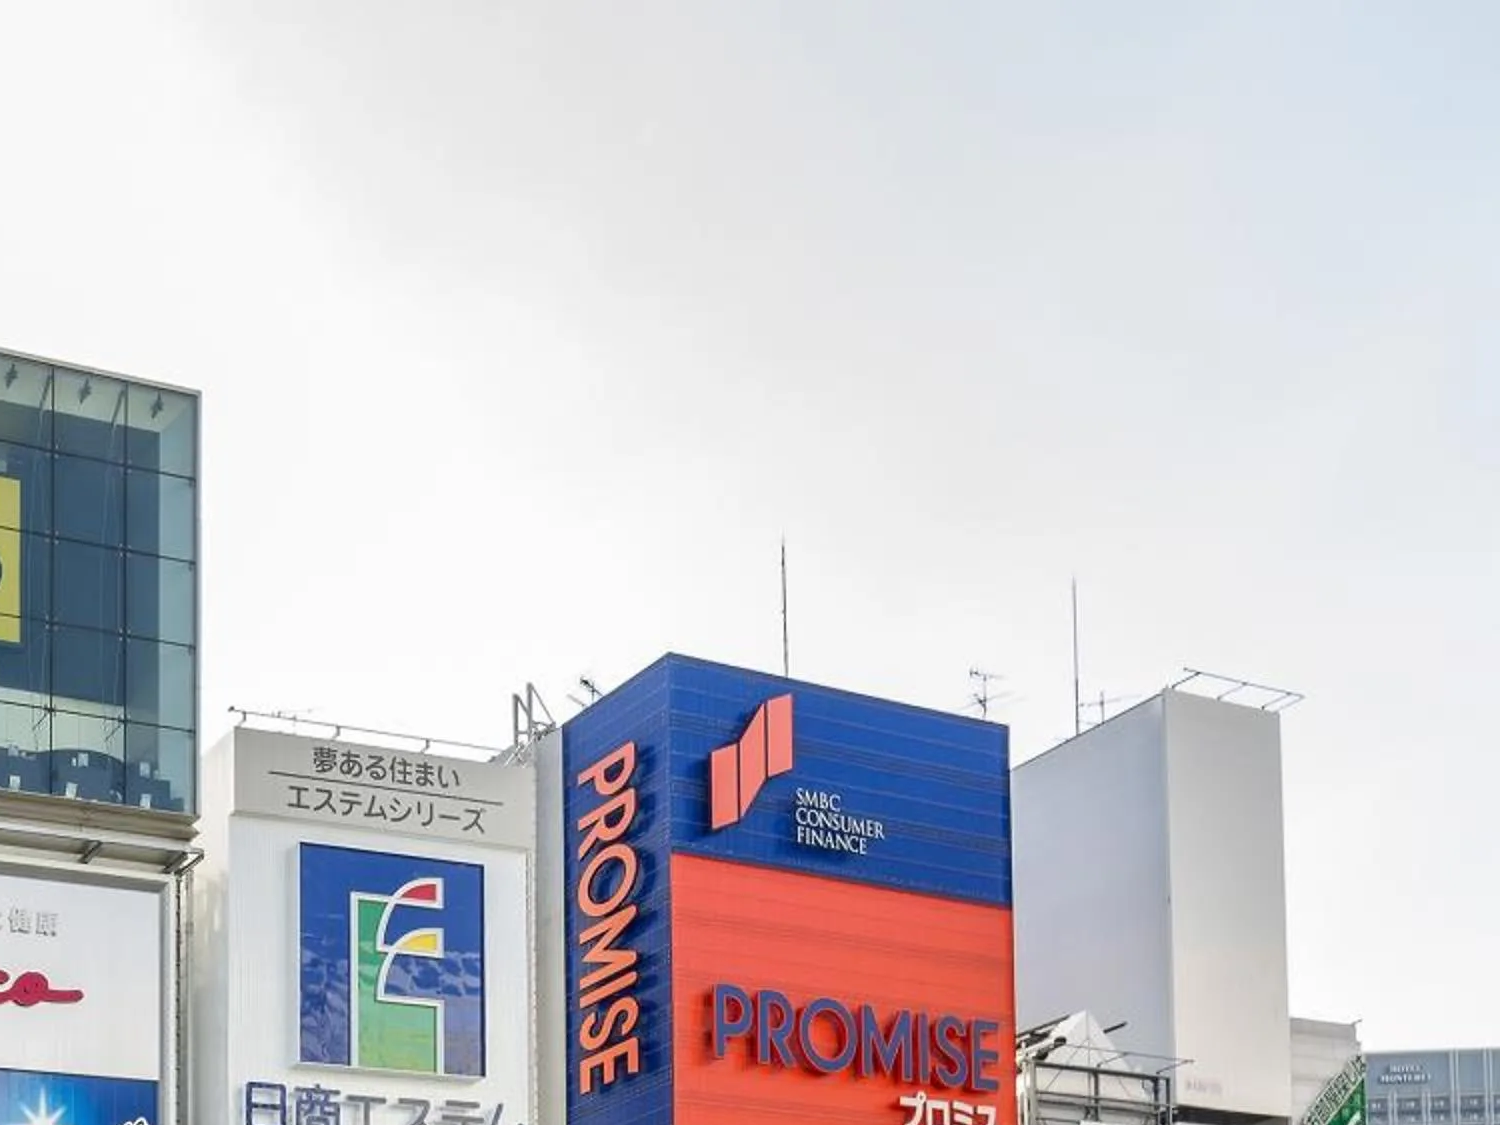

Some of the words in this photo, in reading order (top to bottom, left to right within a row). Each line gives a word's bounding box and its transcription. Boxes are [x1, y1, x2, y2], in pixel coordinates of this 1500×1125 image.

[313, 747, 460, 789] 夢ある住まい
[287, 785, 486, 834] エステムシリーズ
[796, 788, 841, 812] SMBC
[796, 807, 885, 839] CONSUMER
[796, 826, 869, 855] FINANCE
[577, 740, 640, 1095] PROMISE
[713, 983, 1000, 1092] PROMISE
